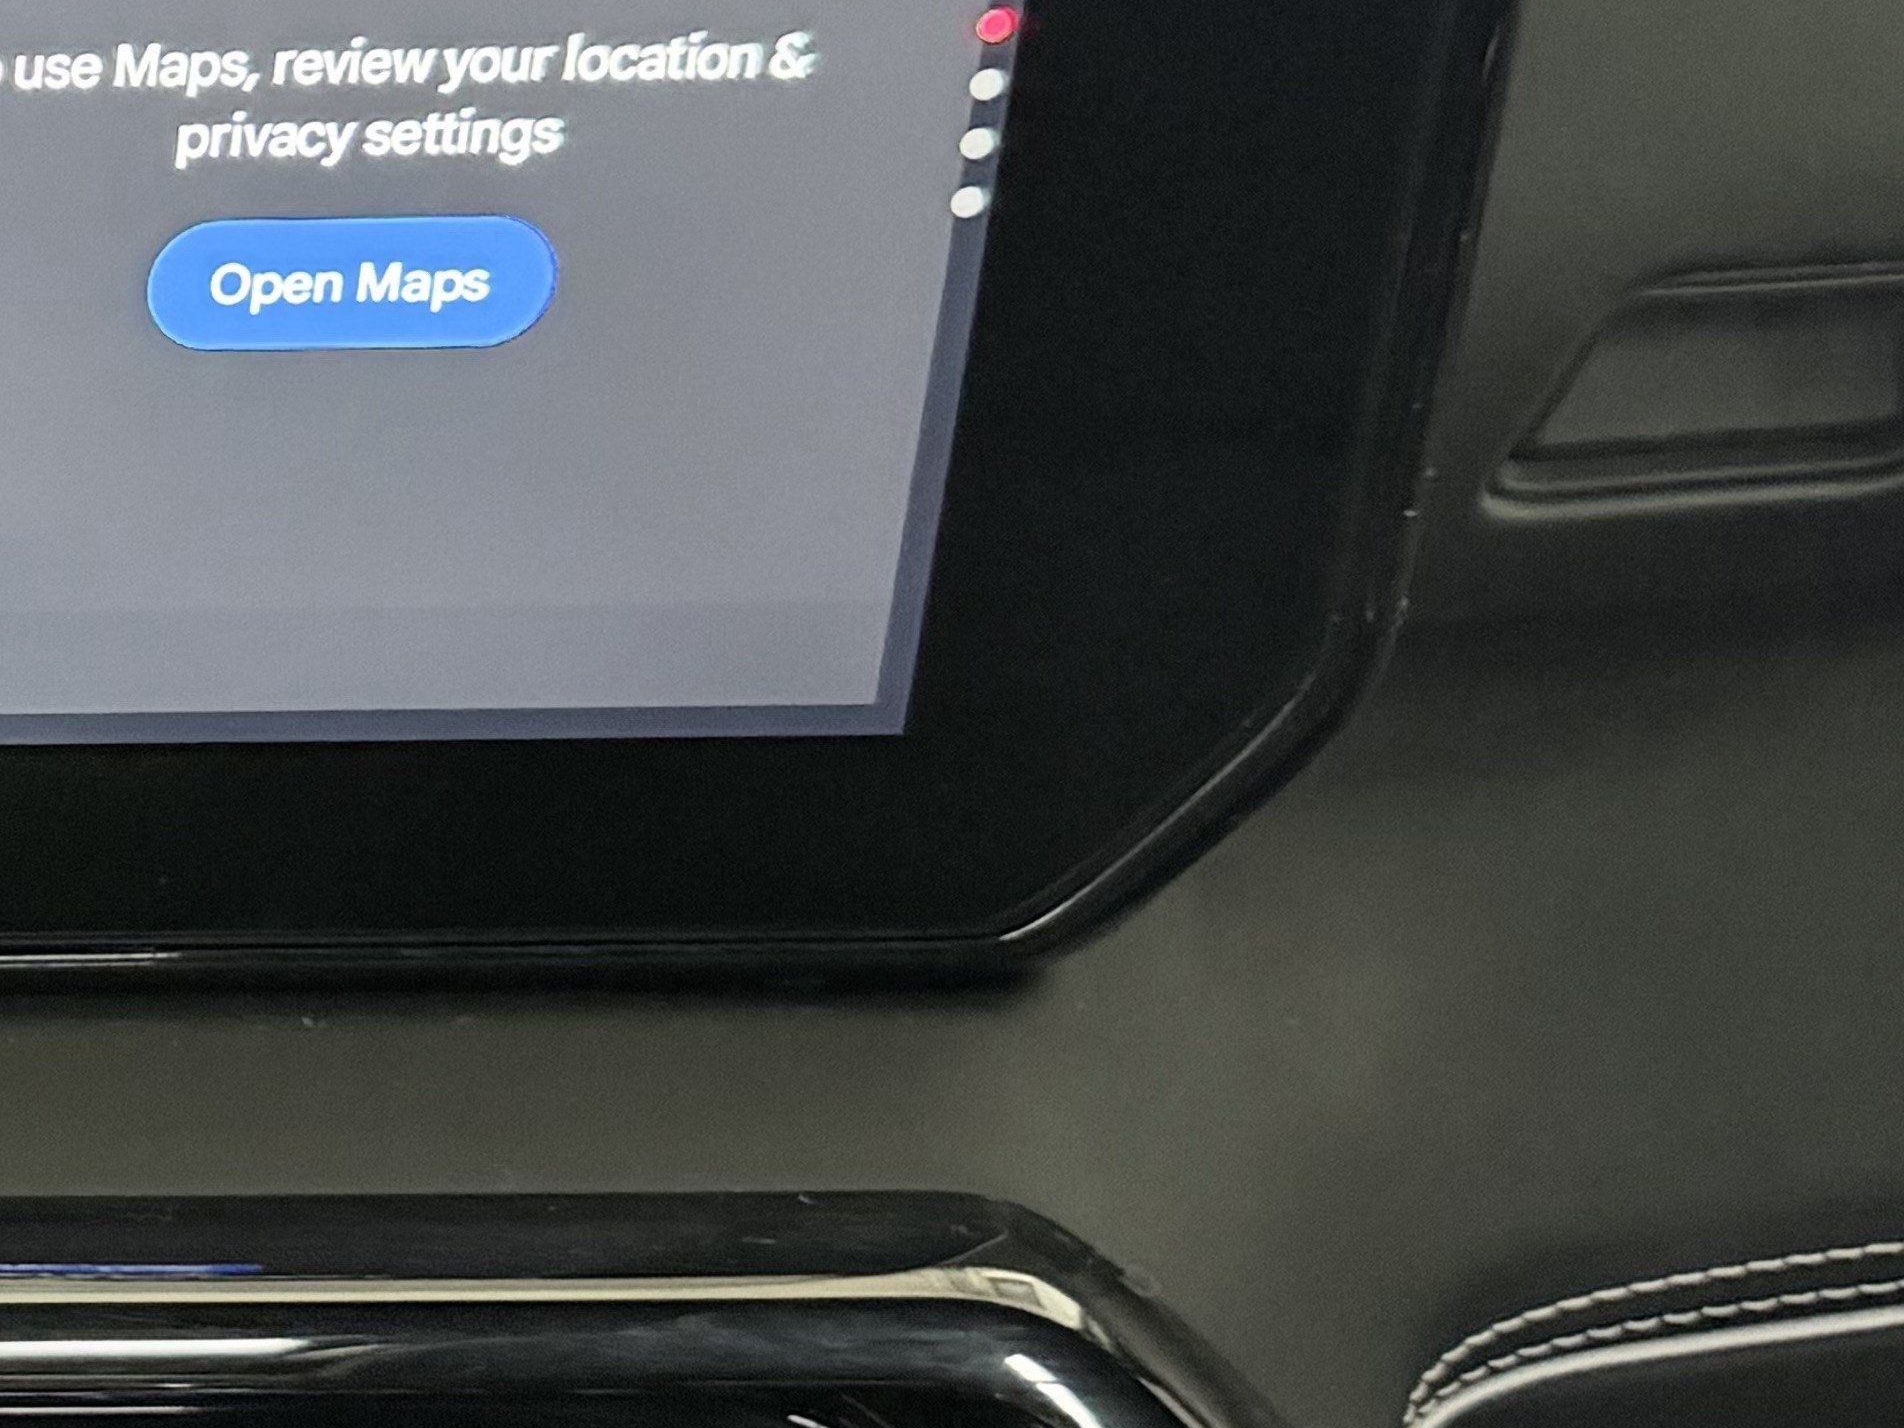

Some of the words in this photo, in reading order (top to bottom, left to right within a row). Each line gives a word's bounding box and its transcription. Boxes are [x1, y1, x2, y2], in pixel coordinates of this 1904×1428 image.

[13, 52, 104, 91] use
[111, 42, 261, 99] Maps,
[271, 35, 437, 87] review
[436, 43, 560, 95] your
[560, 29, 765, 82] location
[767, 29, 822, 82] &
[174, 109, 361, 170] privacy
[362, 106, 567, 167] settings
[208, 261, 344, 316] Open
[356, 260, 492, 314] Maps
